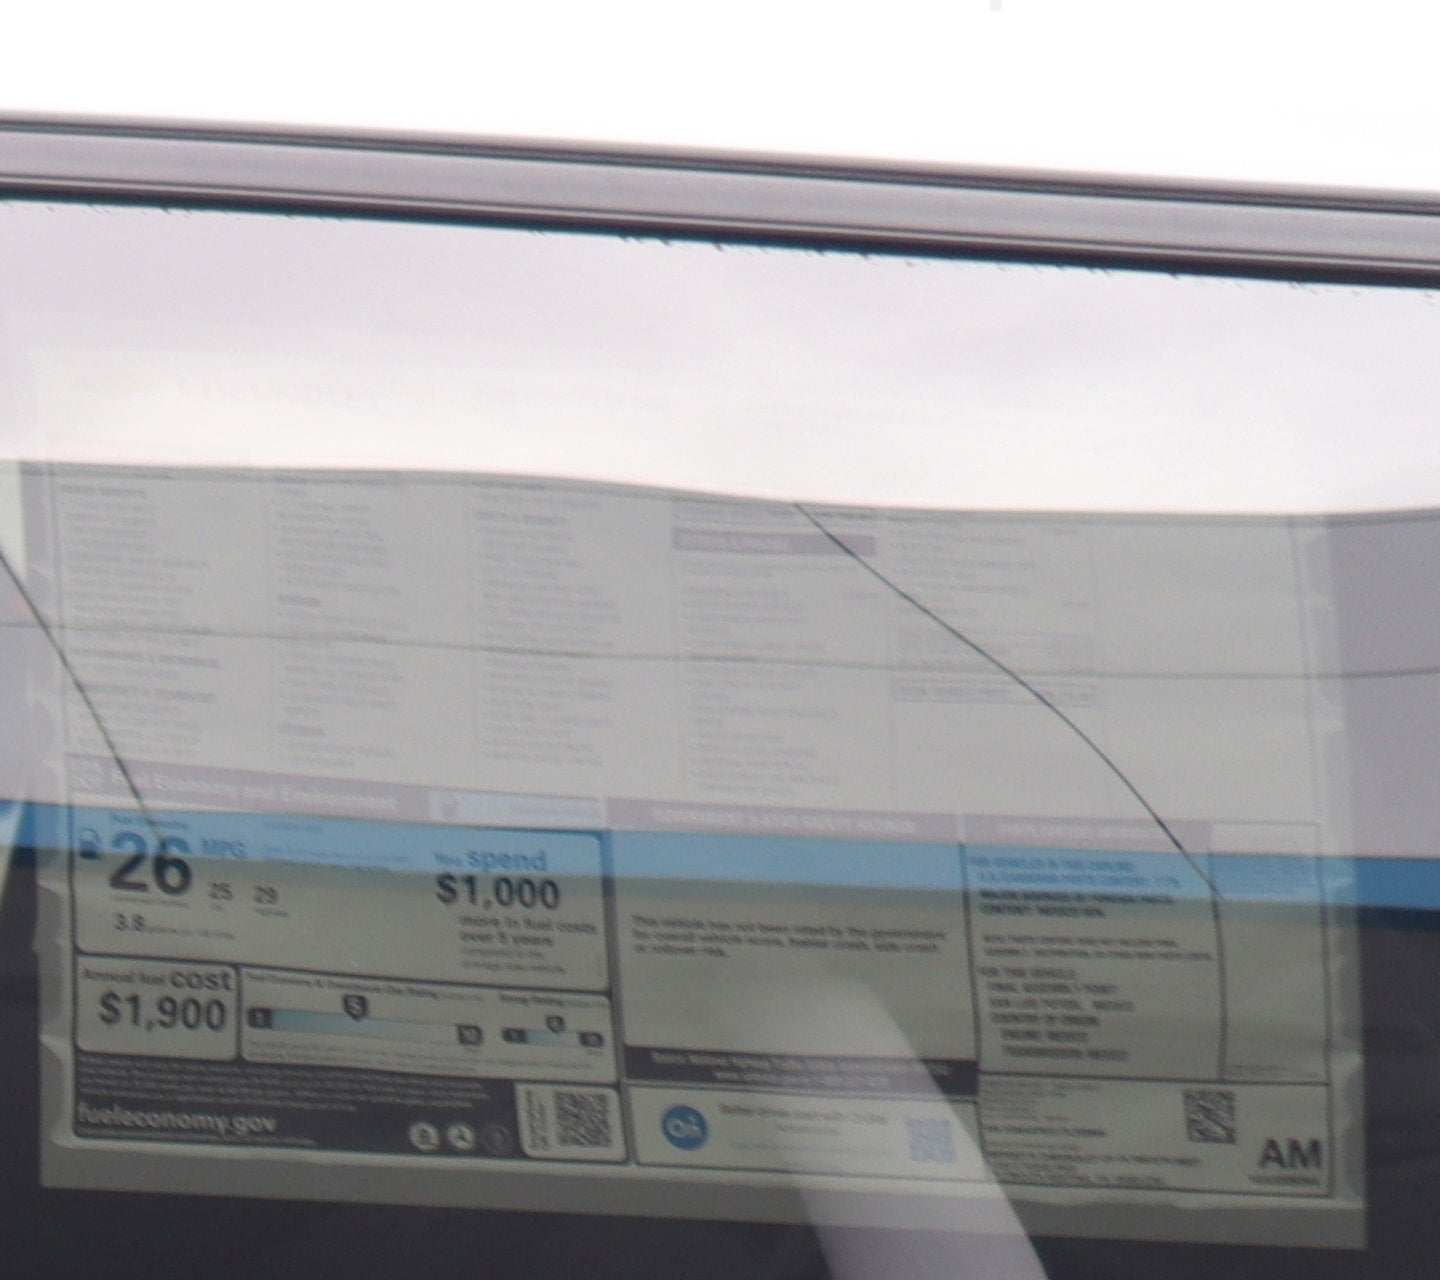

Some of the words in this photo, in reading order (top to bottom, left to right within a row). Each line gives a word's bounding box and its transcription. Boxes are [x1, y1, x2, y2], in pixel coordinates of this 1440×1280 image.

[109, 831, 193, 897] 26
[201, 838, 247, 859] MPG
[467, 850, 548, 874] spend
[435, 871, 561, 910] $1,000
[170, 970, 233, 992] cost
[98, 990, 227, 1033] $1,900
[78, 1103, 280, 1138] fueleconomy.gov
[1259, 1138, 1322, 1169] AM
